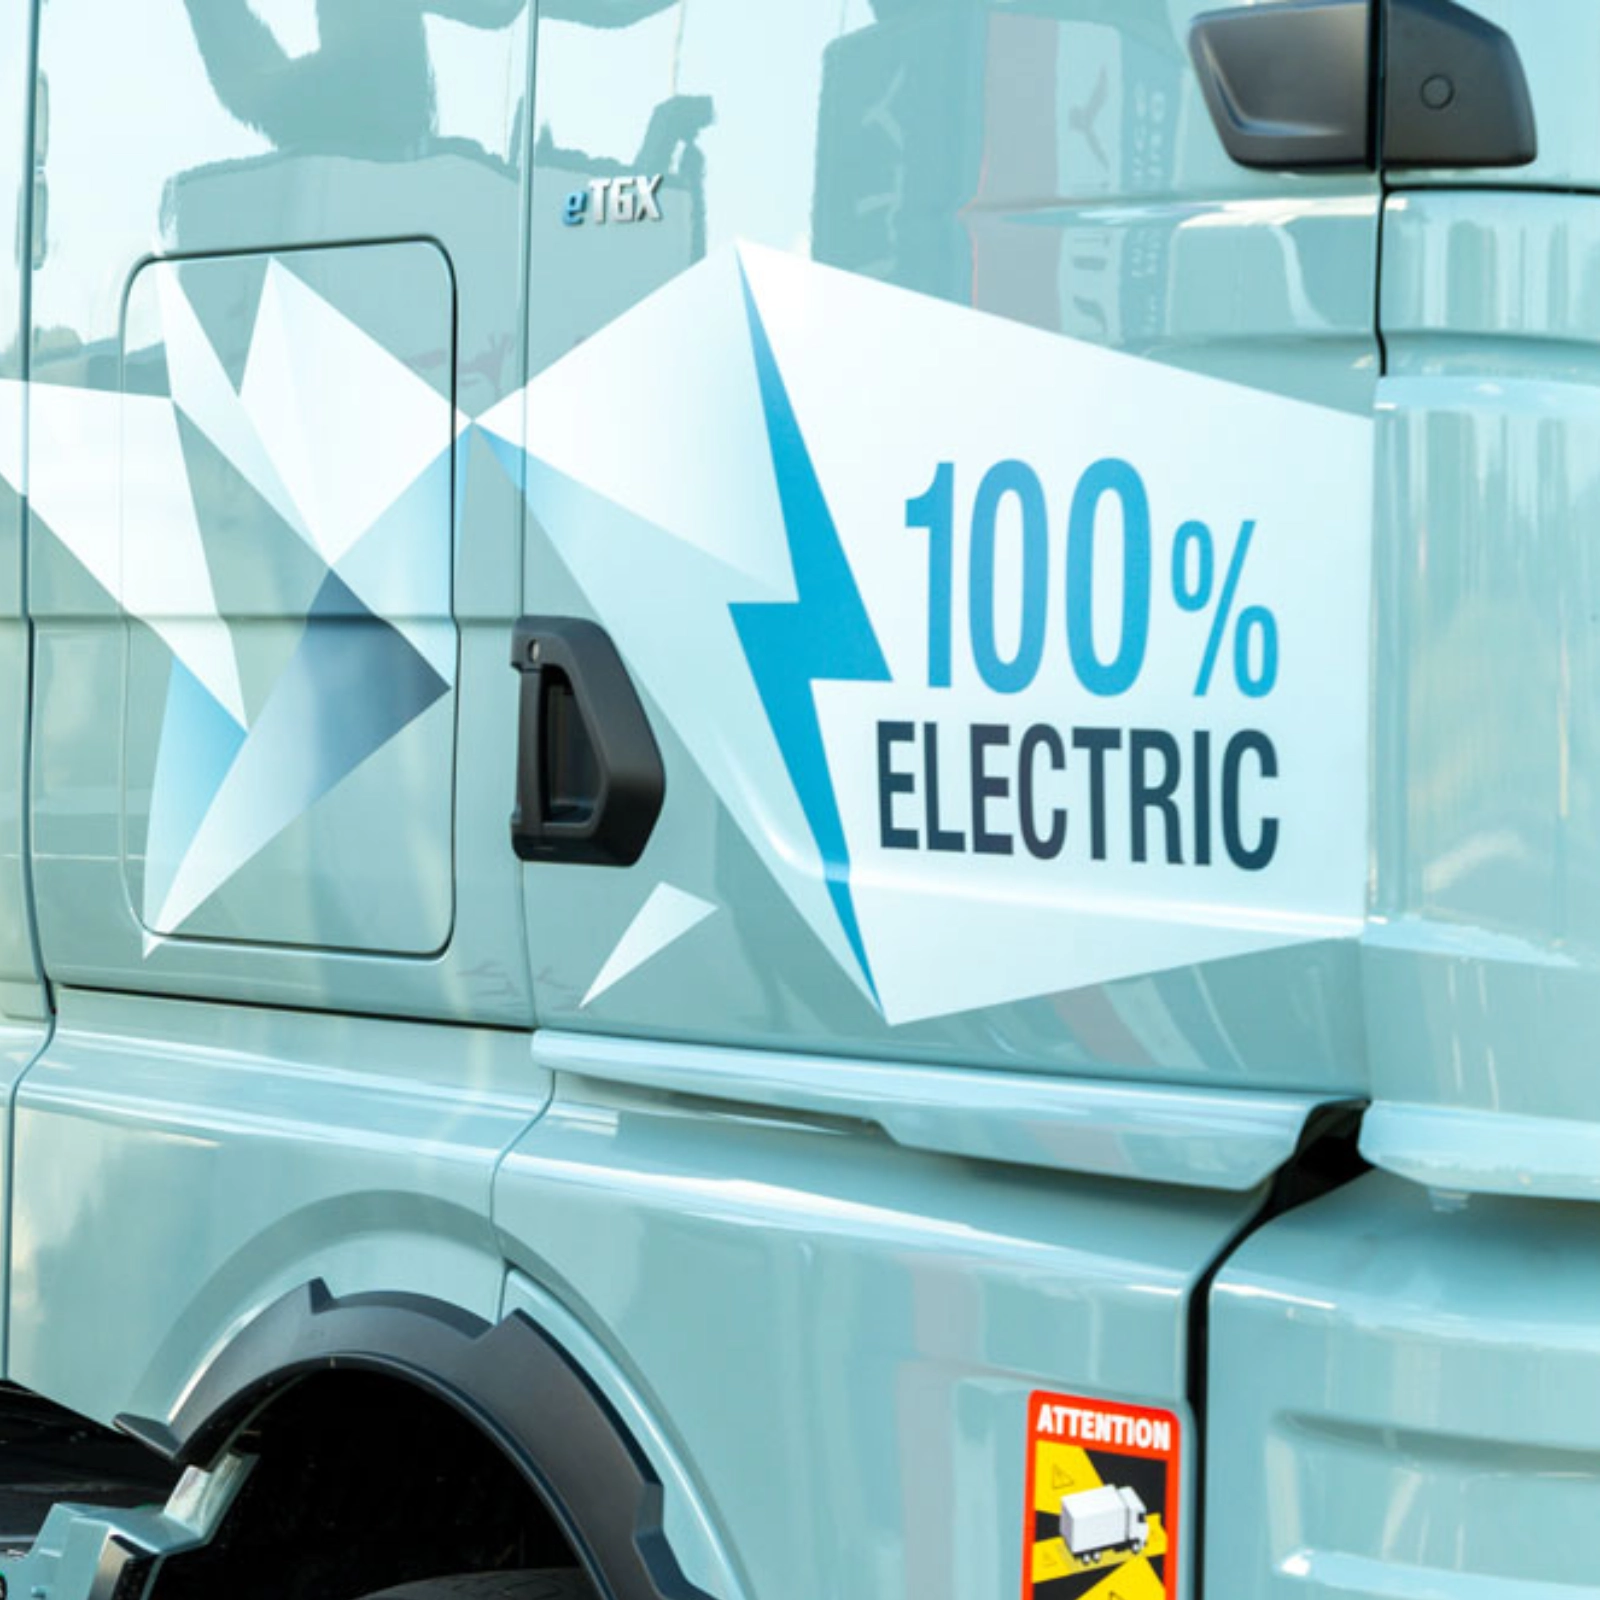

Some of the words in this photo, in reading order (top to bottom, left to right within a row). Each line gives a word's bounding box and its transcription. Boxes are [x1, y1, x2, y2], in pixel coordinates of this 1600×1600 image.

[562, 173, 663, 227] eTGX
[903, 457, 1279, 699] 100%
[875, 719, 1280, 872] ELECTRIC
[1036, 1403, 1171, 1452] ATTENTION
